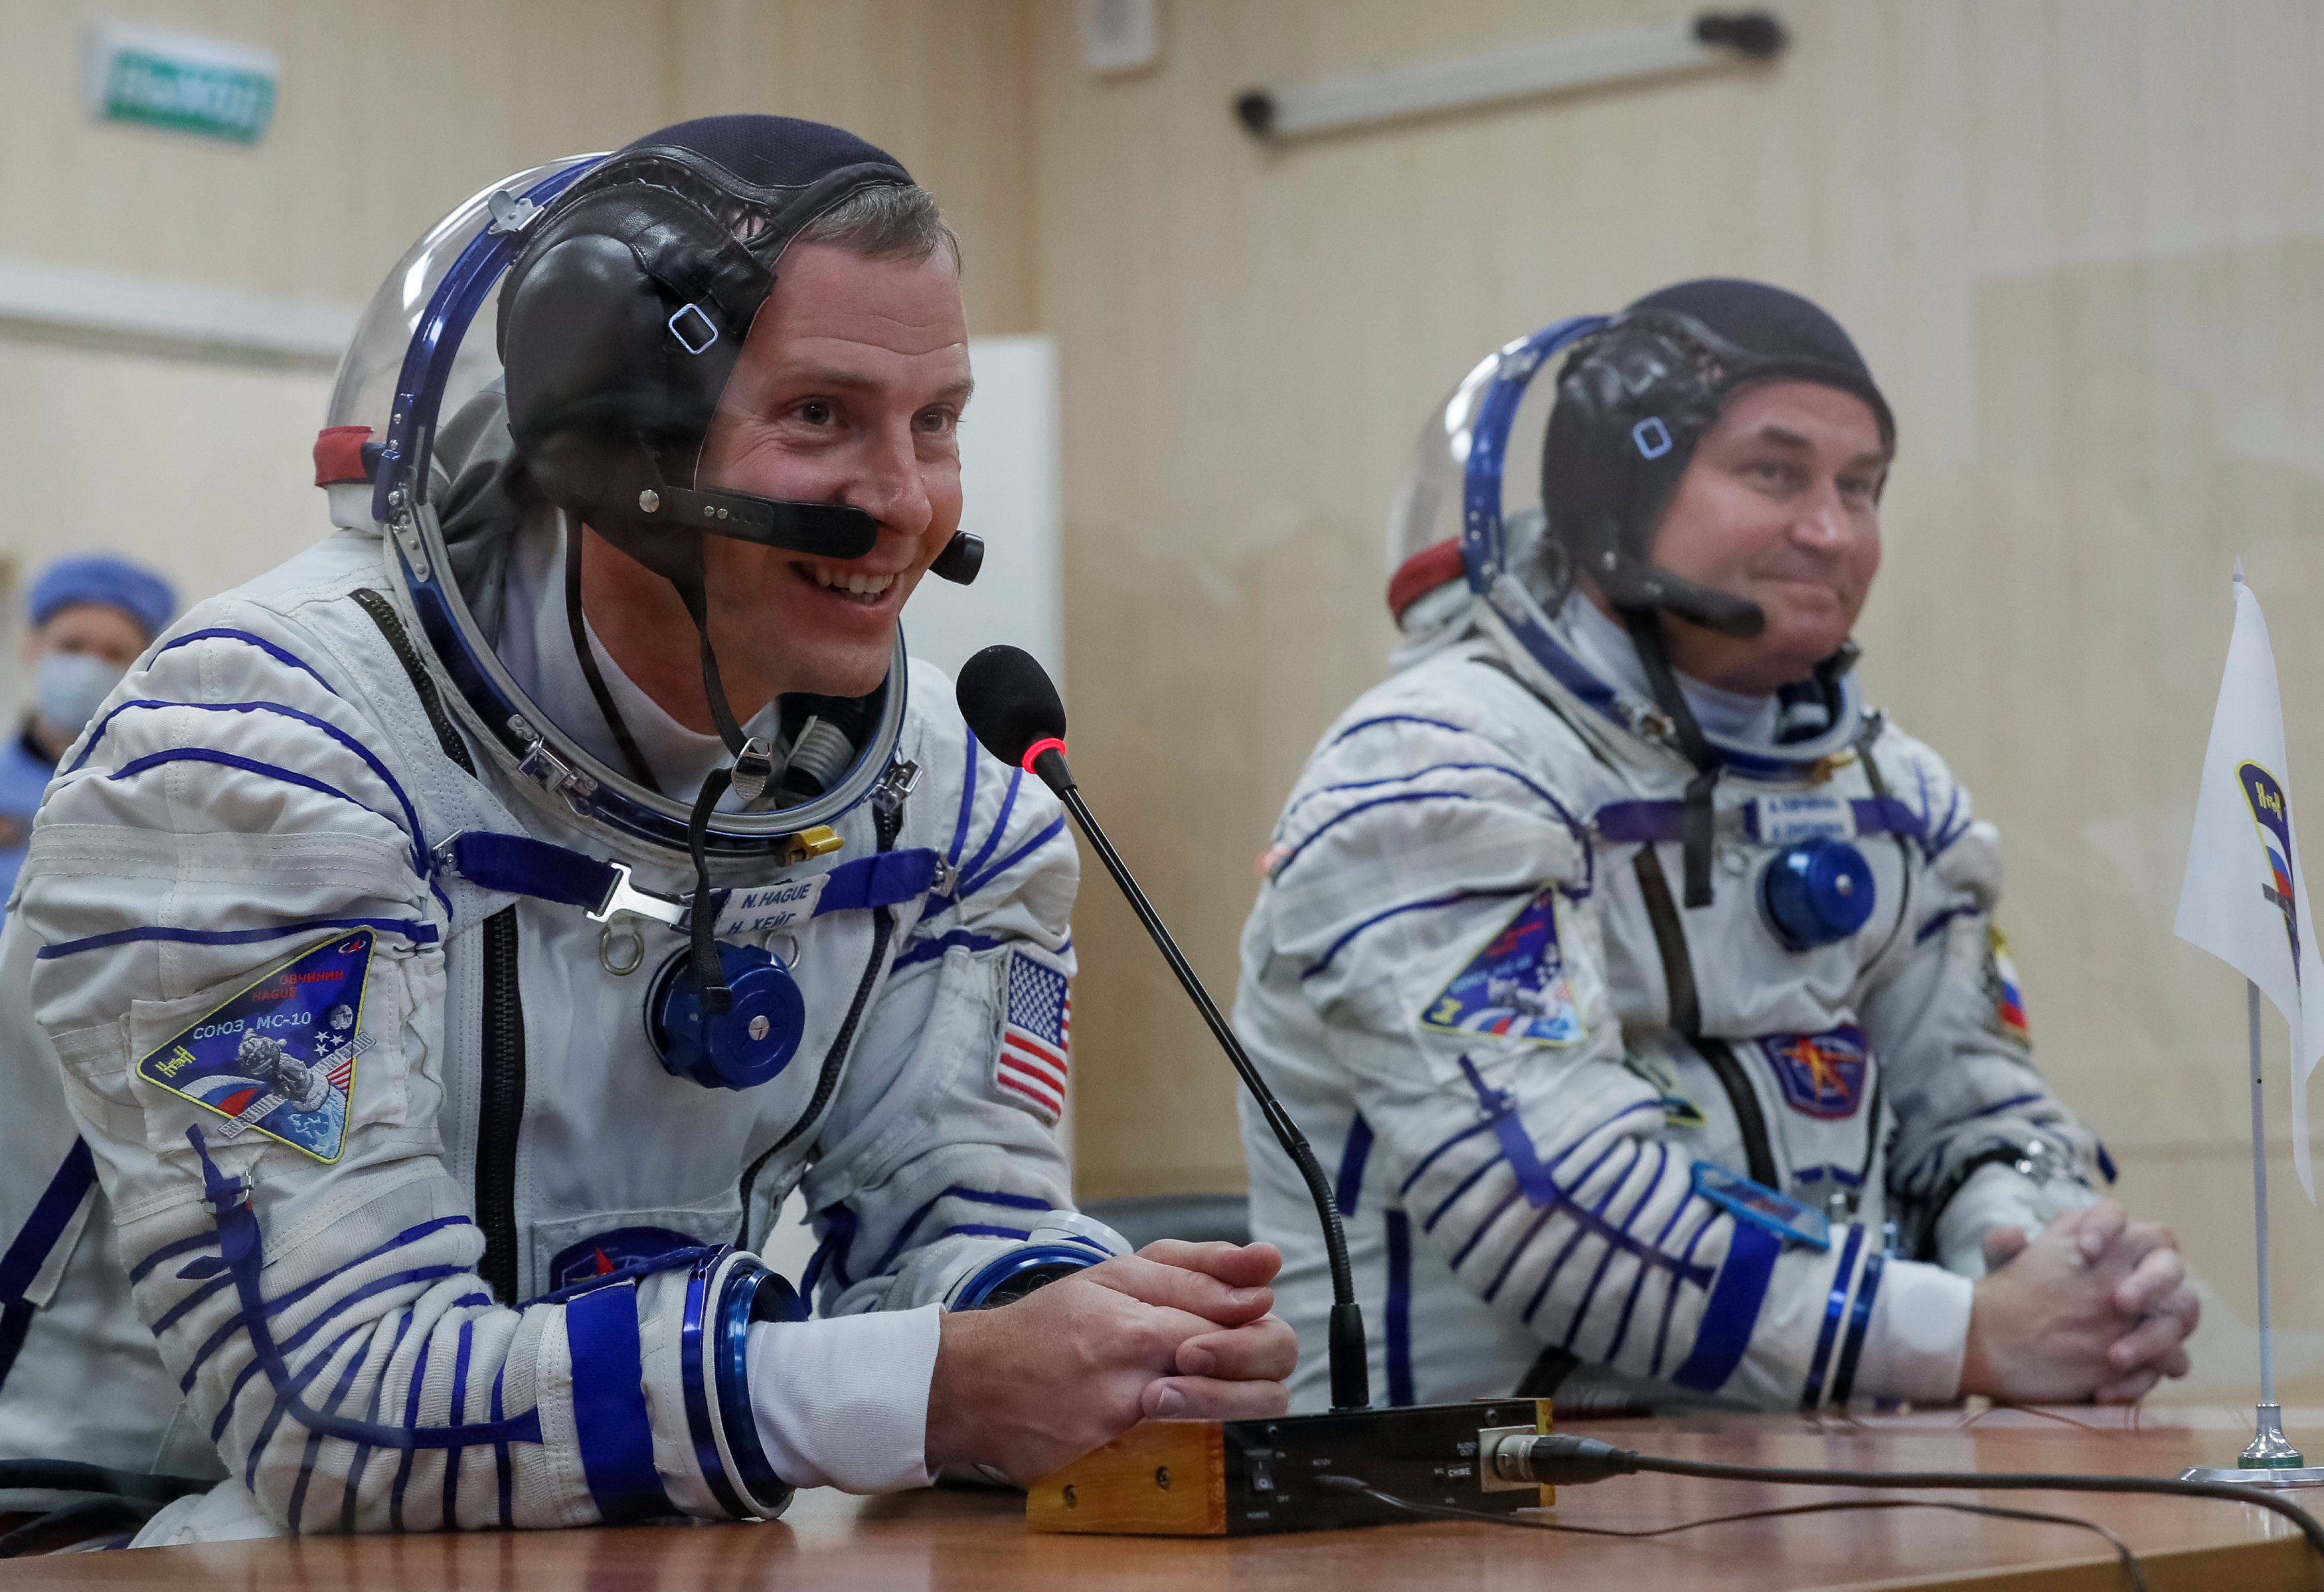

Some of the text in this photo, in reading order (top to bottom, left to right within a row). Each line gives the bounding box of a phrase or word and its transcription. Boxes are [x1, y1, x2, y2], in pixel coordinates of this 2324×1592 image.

[758, 883, 812, 907] HAGUE
[748, 911, 797, 933] ХЕЙГ
[193, 1011, 312, 1040] СОЮЗ МС-10
